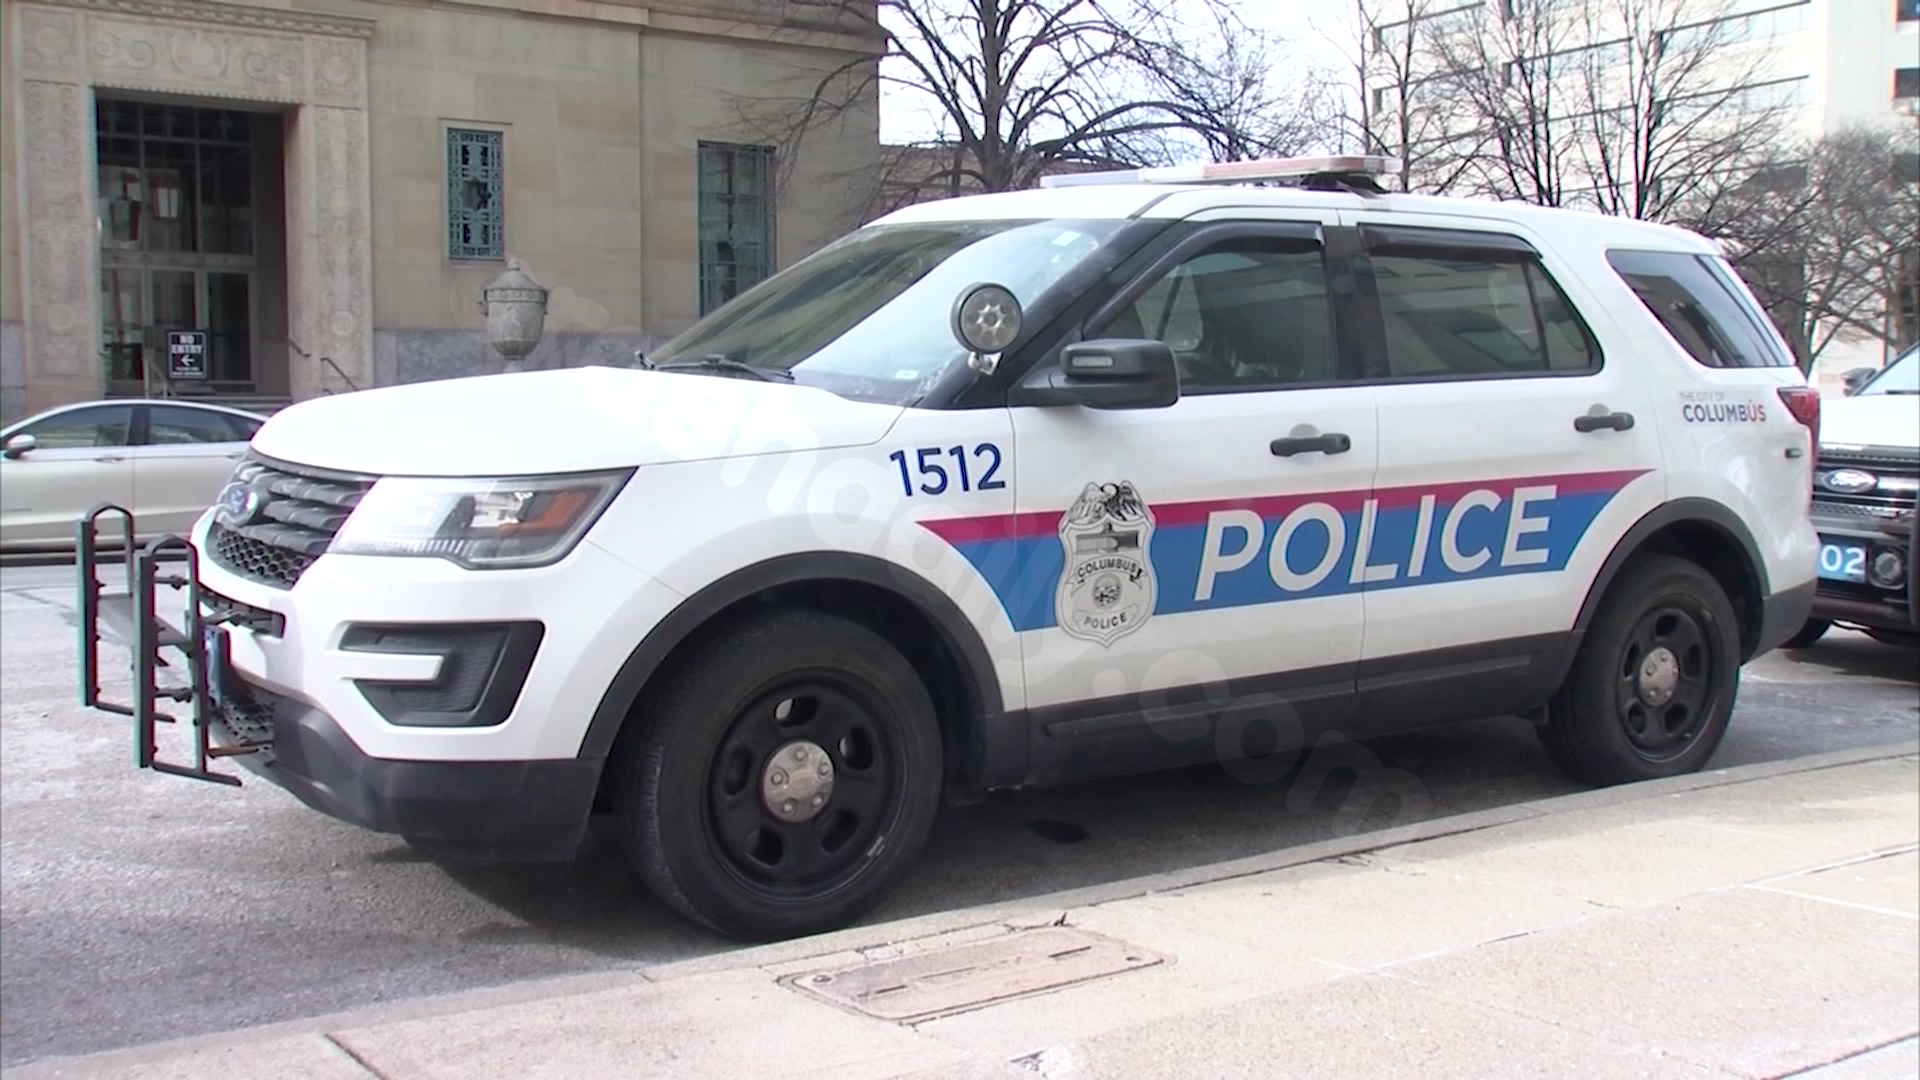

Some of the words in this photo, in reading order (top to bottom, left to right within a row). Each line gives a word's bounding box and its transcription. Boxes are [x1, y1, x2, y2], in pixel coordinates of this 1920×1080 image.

[171, 344, 202, 354] ENTRY
[180, 335, 195, 344] NO
[1682, 402, 1767, 423] COLUMBUS
[889, 442, 1006, 497] 1512
[1194, 484, 1558, 601] POLICE
[1077, 558, 1137, 578] COLUMBUS
[1820, 544, 1866, 575] 02
[1083, 612, 1127, 630] POLICE
